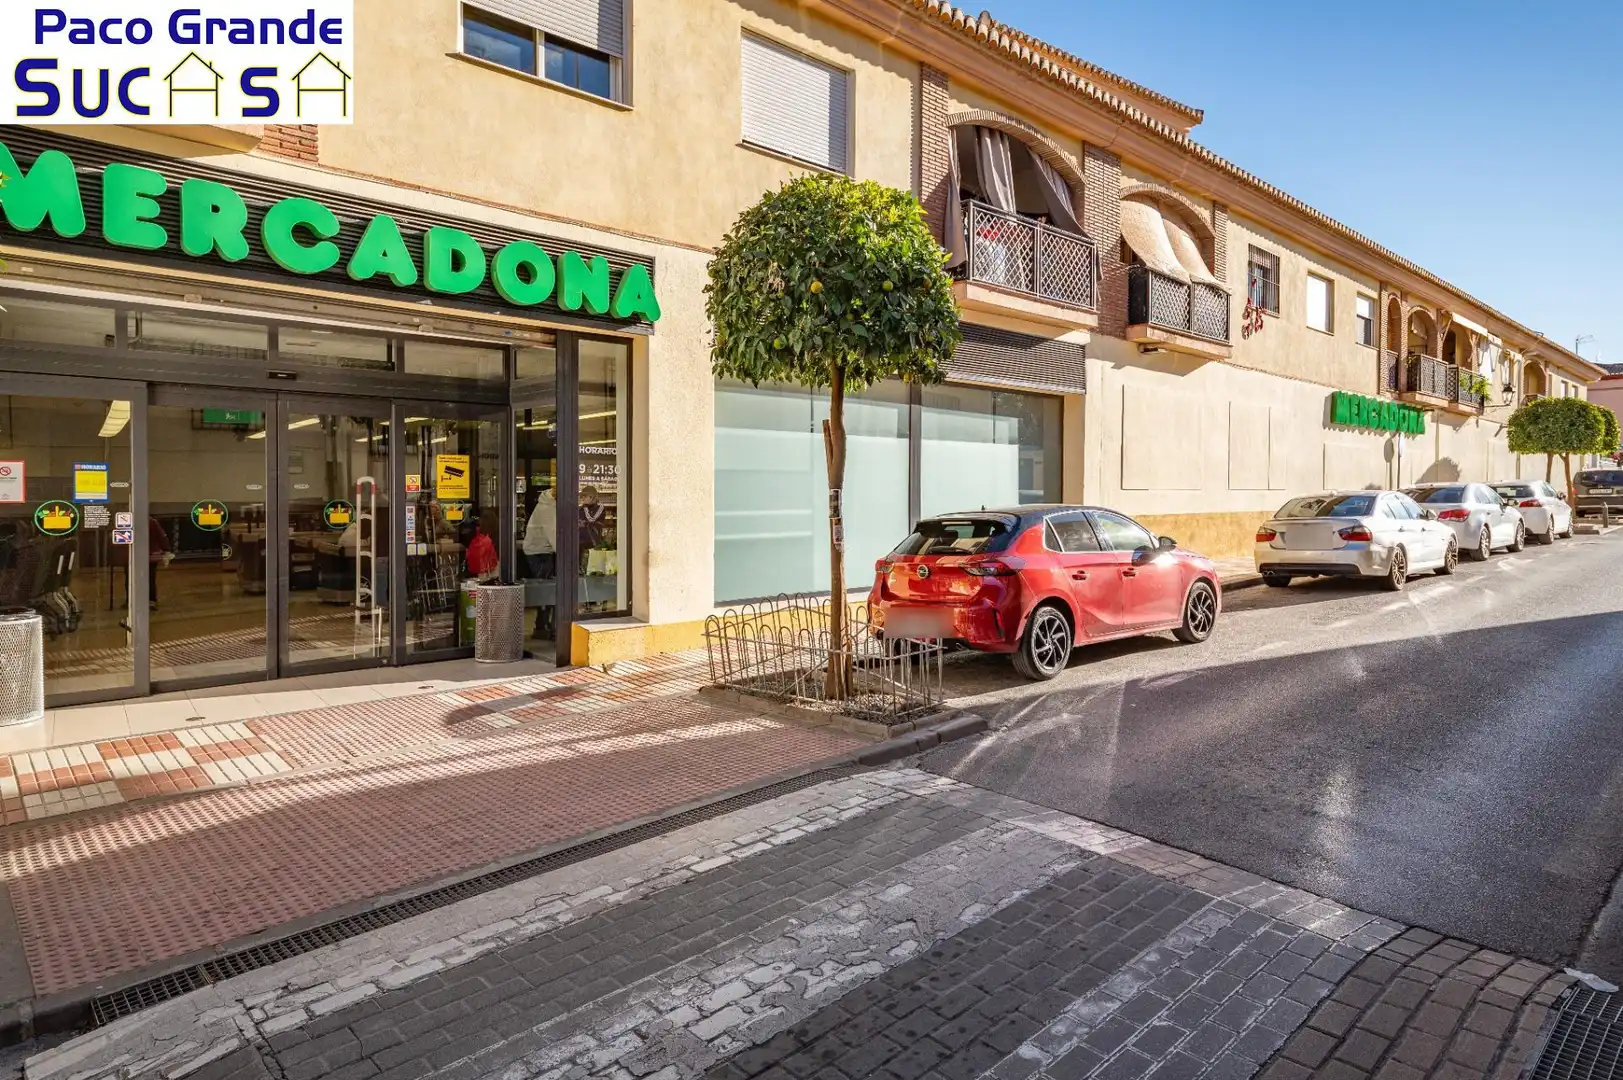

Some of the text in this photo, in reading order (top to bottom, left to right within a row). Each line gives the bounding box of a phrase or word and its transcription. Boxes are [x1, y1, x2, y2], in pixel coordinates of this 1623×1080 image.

[0, 141, 662, 322] MERCADONA
[579, 446, 617, 455] HORARIO
[579, 463, 586, 474] 9
[593, 464, 621, 475] 21:30
